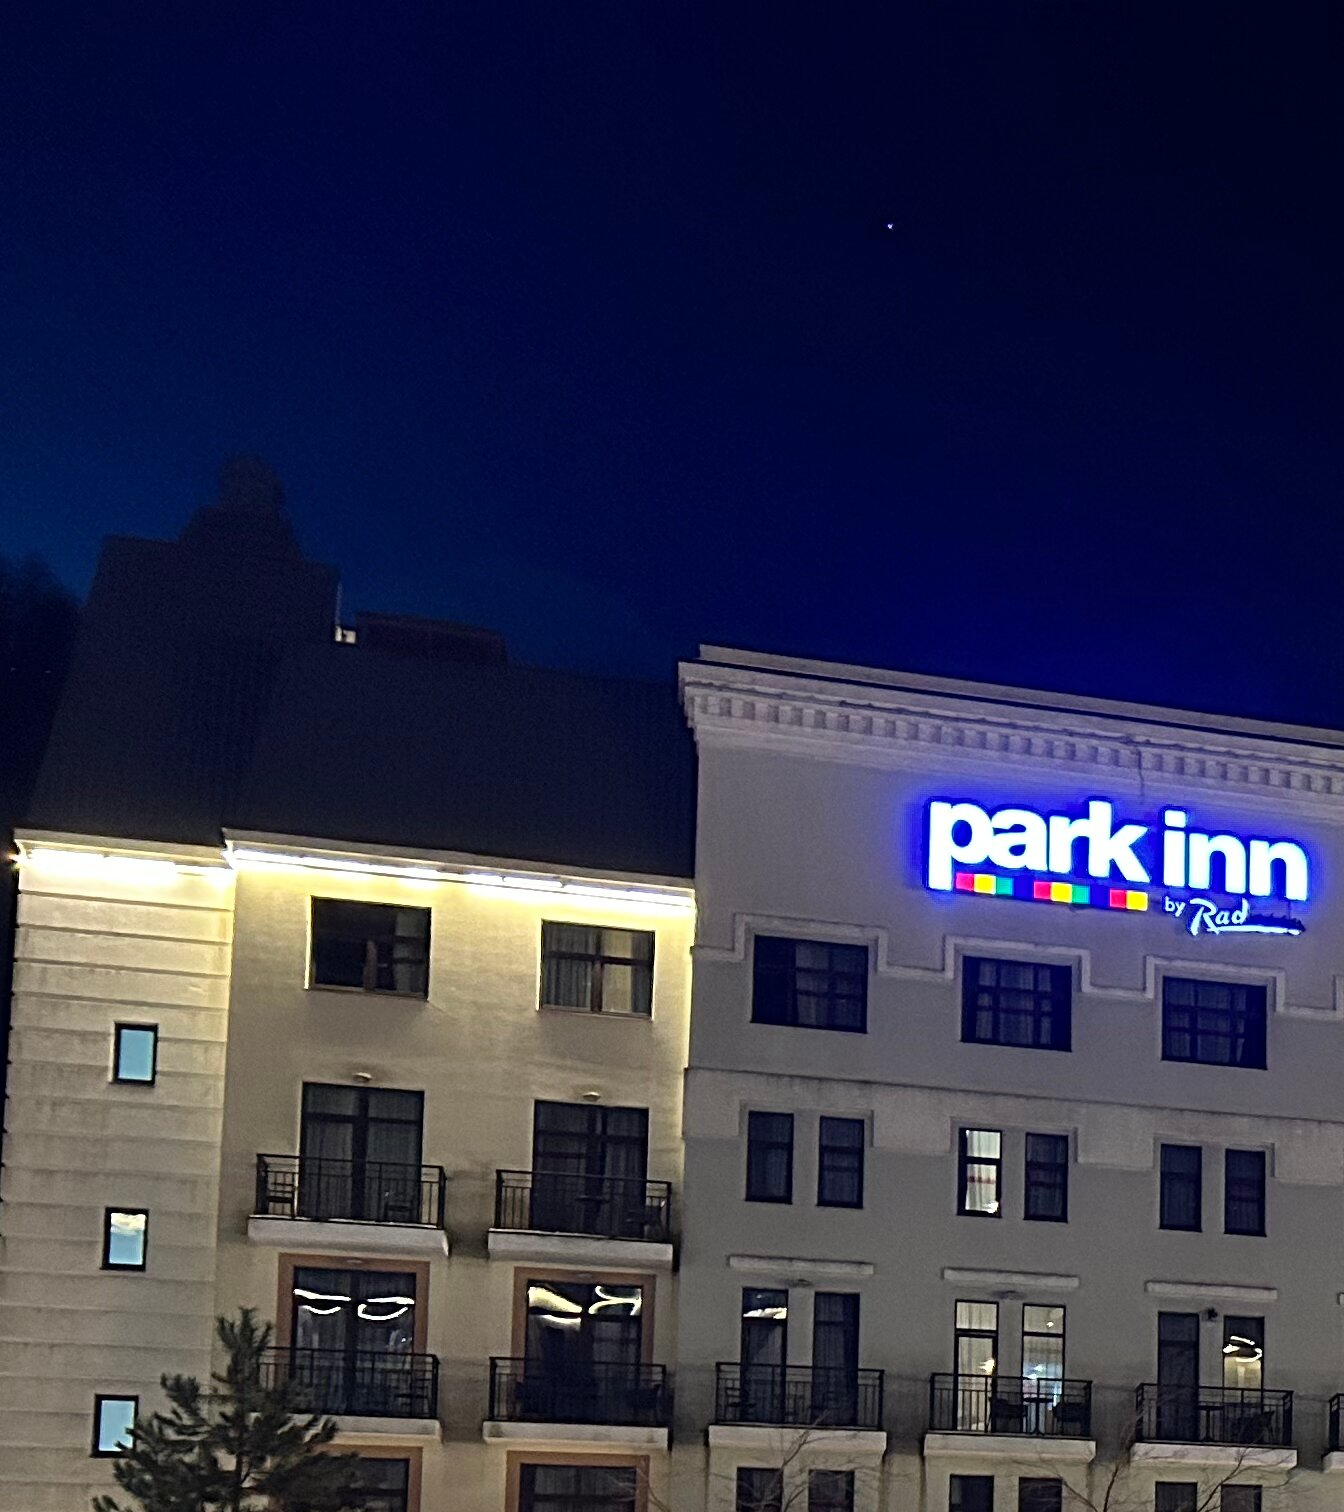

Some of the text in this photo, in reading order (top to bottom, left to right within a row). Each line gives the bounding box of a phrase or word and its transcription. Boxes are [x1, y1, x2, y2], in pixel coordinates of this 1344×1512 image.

[929, 799, 1308, 901] park inn
[1164, 895, 1186, 917] by
